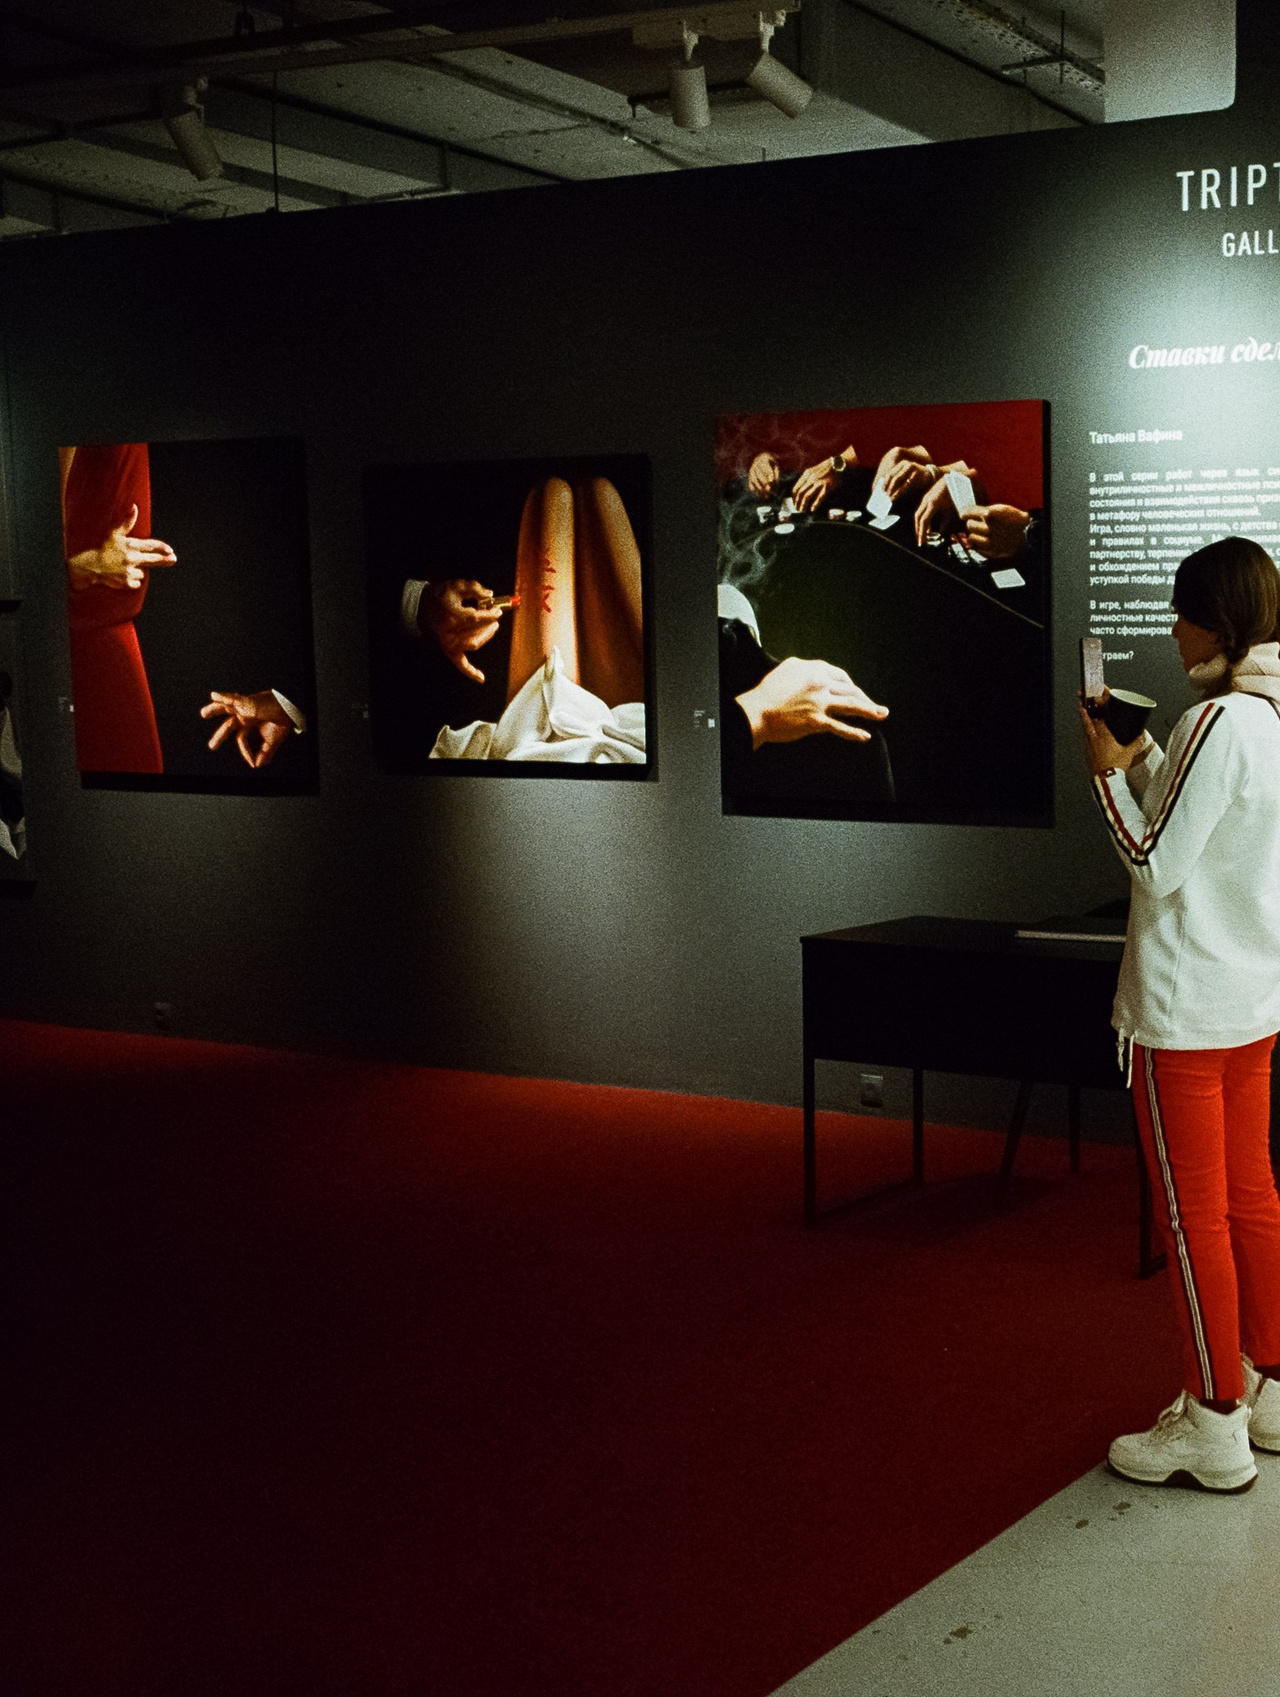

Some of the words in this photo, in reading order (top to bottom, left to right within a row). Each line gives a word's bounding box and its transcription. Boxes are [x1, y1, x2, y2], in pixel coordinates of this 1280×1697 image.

[1128, 344, 1226, 369] Ставки
[1089, 431, 1136, 444] Татьяна
[1137, 429, 1183, 443] Вафина
[1089, 472, 1096, 482] В
[1103, 471, 1124, 481] этой
[1131, 472, 1159, 482] серии
[1165, 469, 1192, 481] работ
[1200, 469, 1227, 479] через
[1235, 468, 1260, 477] язык
[1089, 484, 1175, 496] внутриличностные
[1175, 484, 1182, 492] и
[1089, 498, 1136, 508] состояния
[1137, 498, 1143, 506] и
[1222, 495, 1254, 504] сквозь
[1089, 512, 1096, 520] в
[1097, 510, 1140, 521] метафору
[1206, 506, 1261, 517] отношений.
[1090, 524, 1113, 535] Игра,
[1114, 524, 1147, 533] словно
[1148, 522, 1199, 532] маленькая
[1199, 522, 1231, 532] жизнь,
[1232, 522, 1239, 530] с
[1240, 521, 1277, 531] детства
[1090, 538, 1096, 546] и
[1102, 537, 1144, 547] правилах
[1151, 537, 1157, 545] в
[1163, 536, 1204, 546] социуме.
[1090, 549, 1146, 560] партнерству,
[1099, 561, 1160, 572] обхождением
[1090, 574, 1129, 586] уступкой
[1131, 574, 1165, 585] победы
[1090, 600, 1096, 609] В
[1100, 601, 1121, 611] игре,
[1124, 599, 1170, 610] наблюдая
[1090, 614, 1143, 622] личностные
[1090, 626, 1115, 635] часто
[1117, 625, 1172, 636] сформирова
[1103, 650, 1135, 662] граем?
